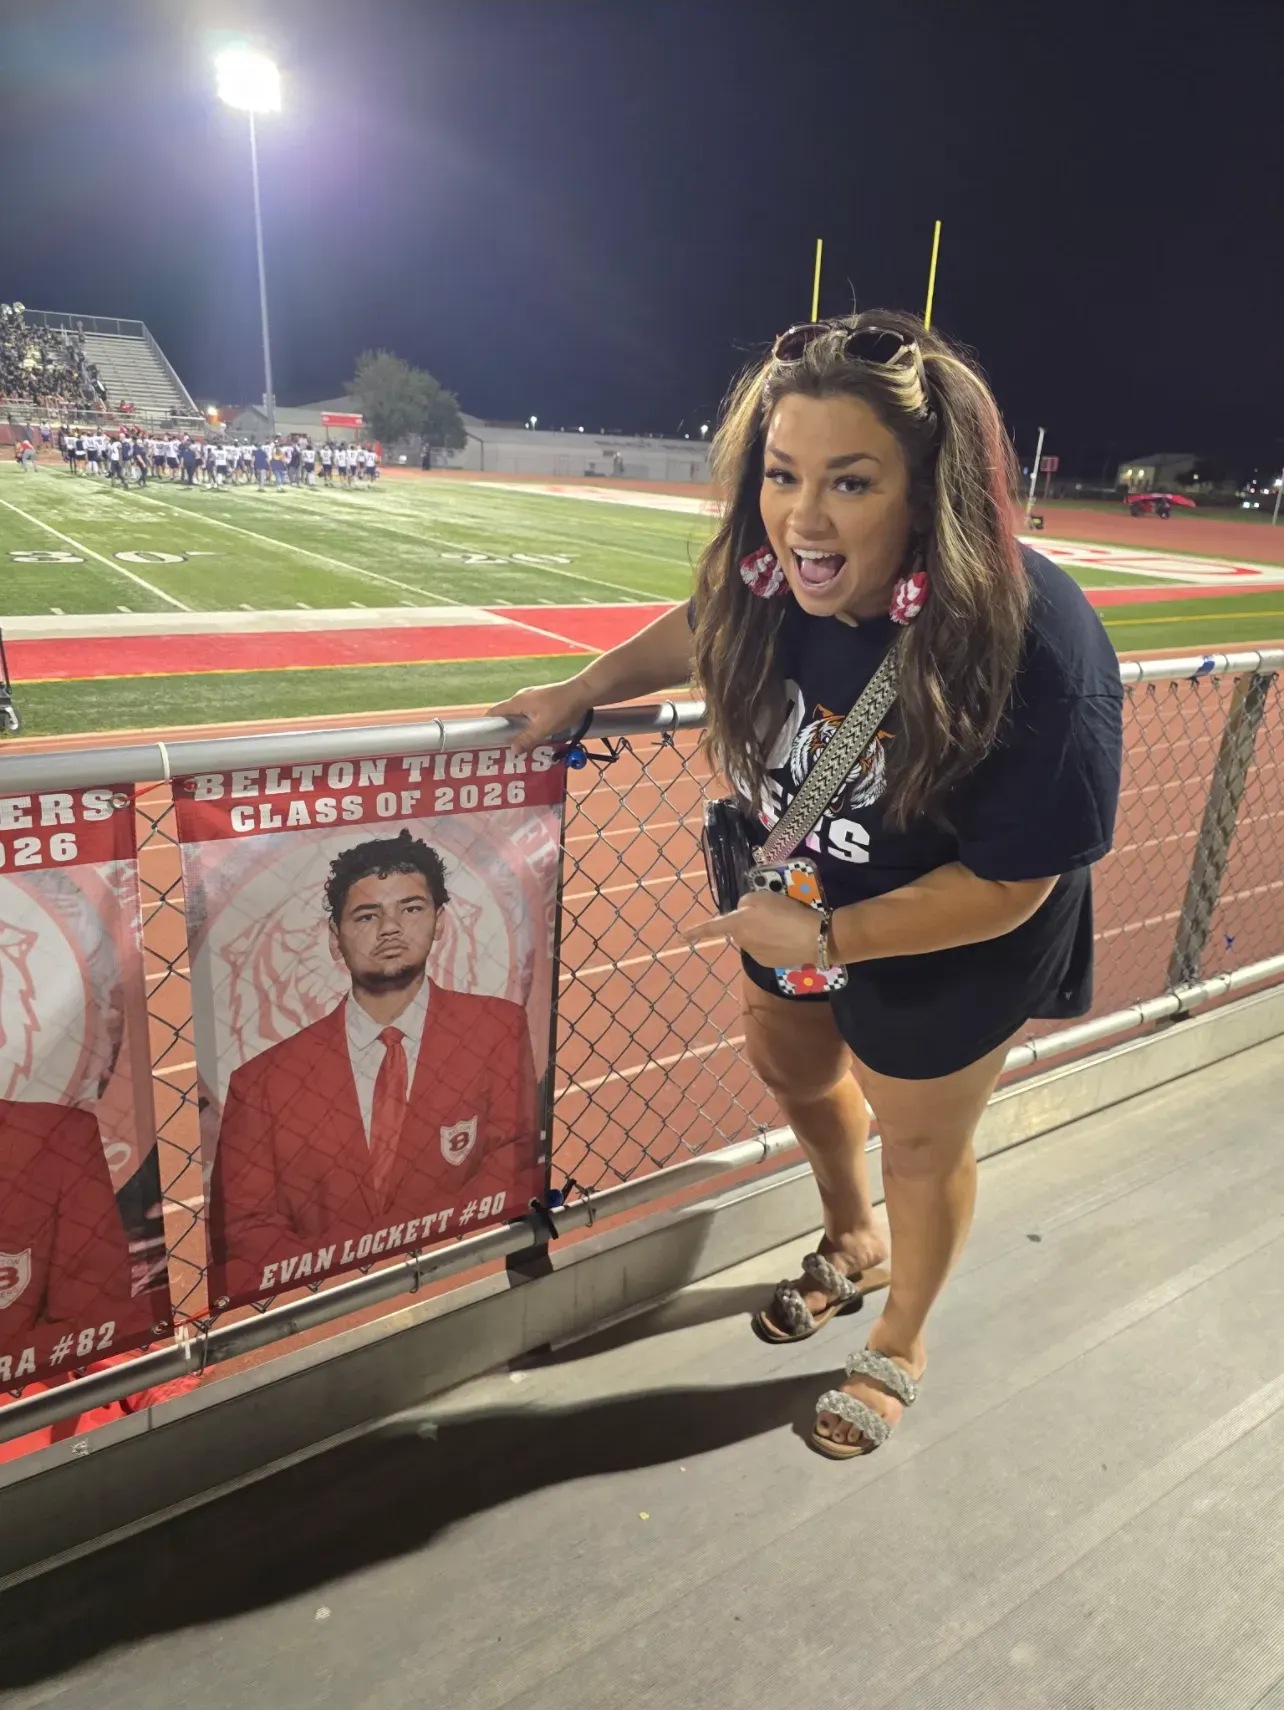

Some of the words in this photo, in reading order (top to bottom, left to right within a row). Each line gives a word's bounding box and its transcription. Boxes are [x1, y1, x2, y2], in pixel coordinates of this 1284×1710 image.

[195, 759, 387, 801] BELTON
[403, 745, 553, 784] TIGERS
[231, 796, 363, 832] CLASS
[376, 790, 421, 817] OF
[434, 780, 526, 812] 2026
[0, 833, 77, 868] 26
[259, 1245, 336, 1290] EVAN
[340, 1208, 454, 1265] LOCKETT
[459, 1192, 506, 1226] #90
[49, 1321, 116, 1366] #82
